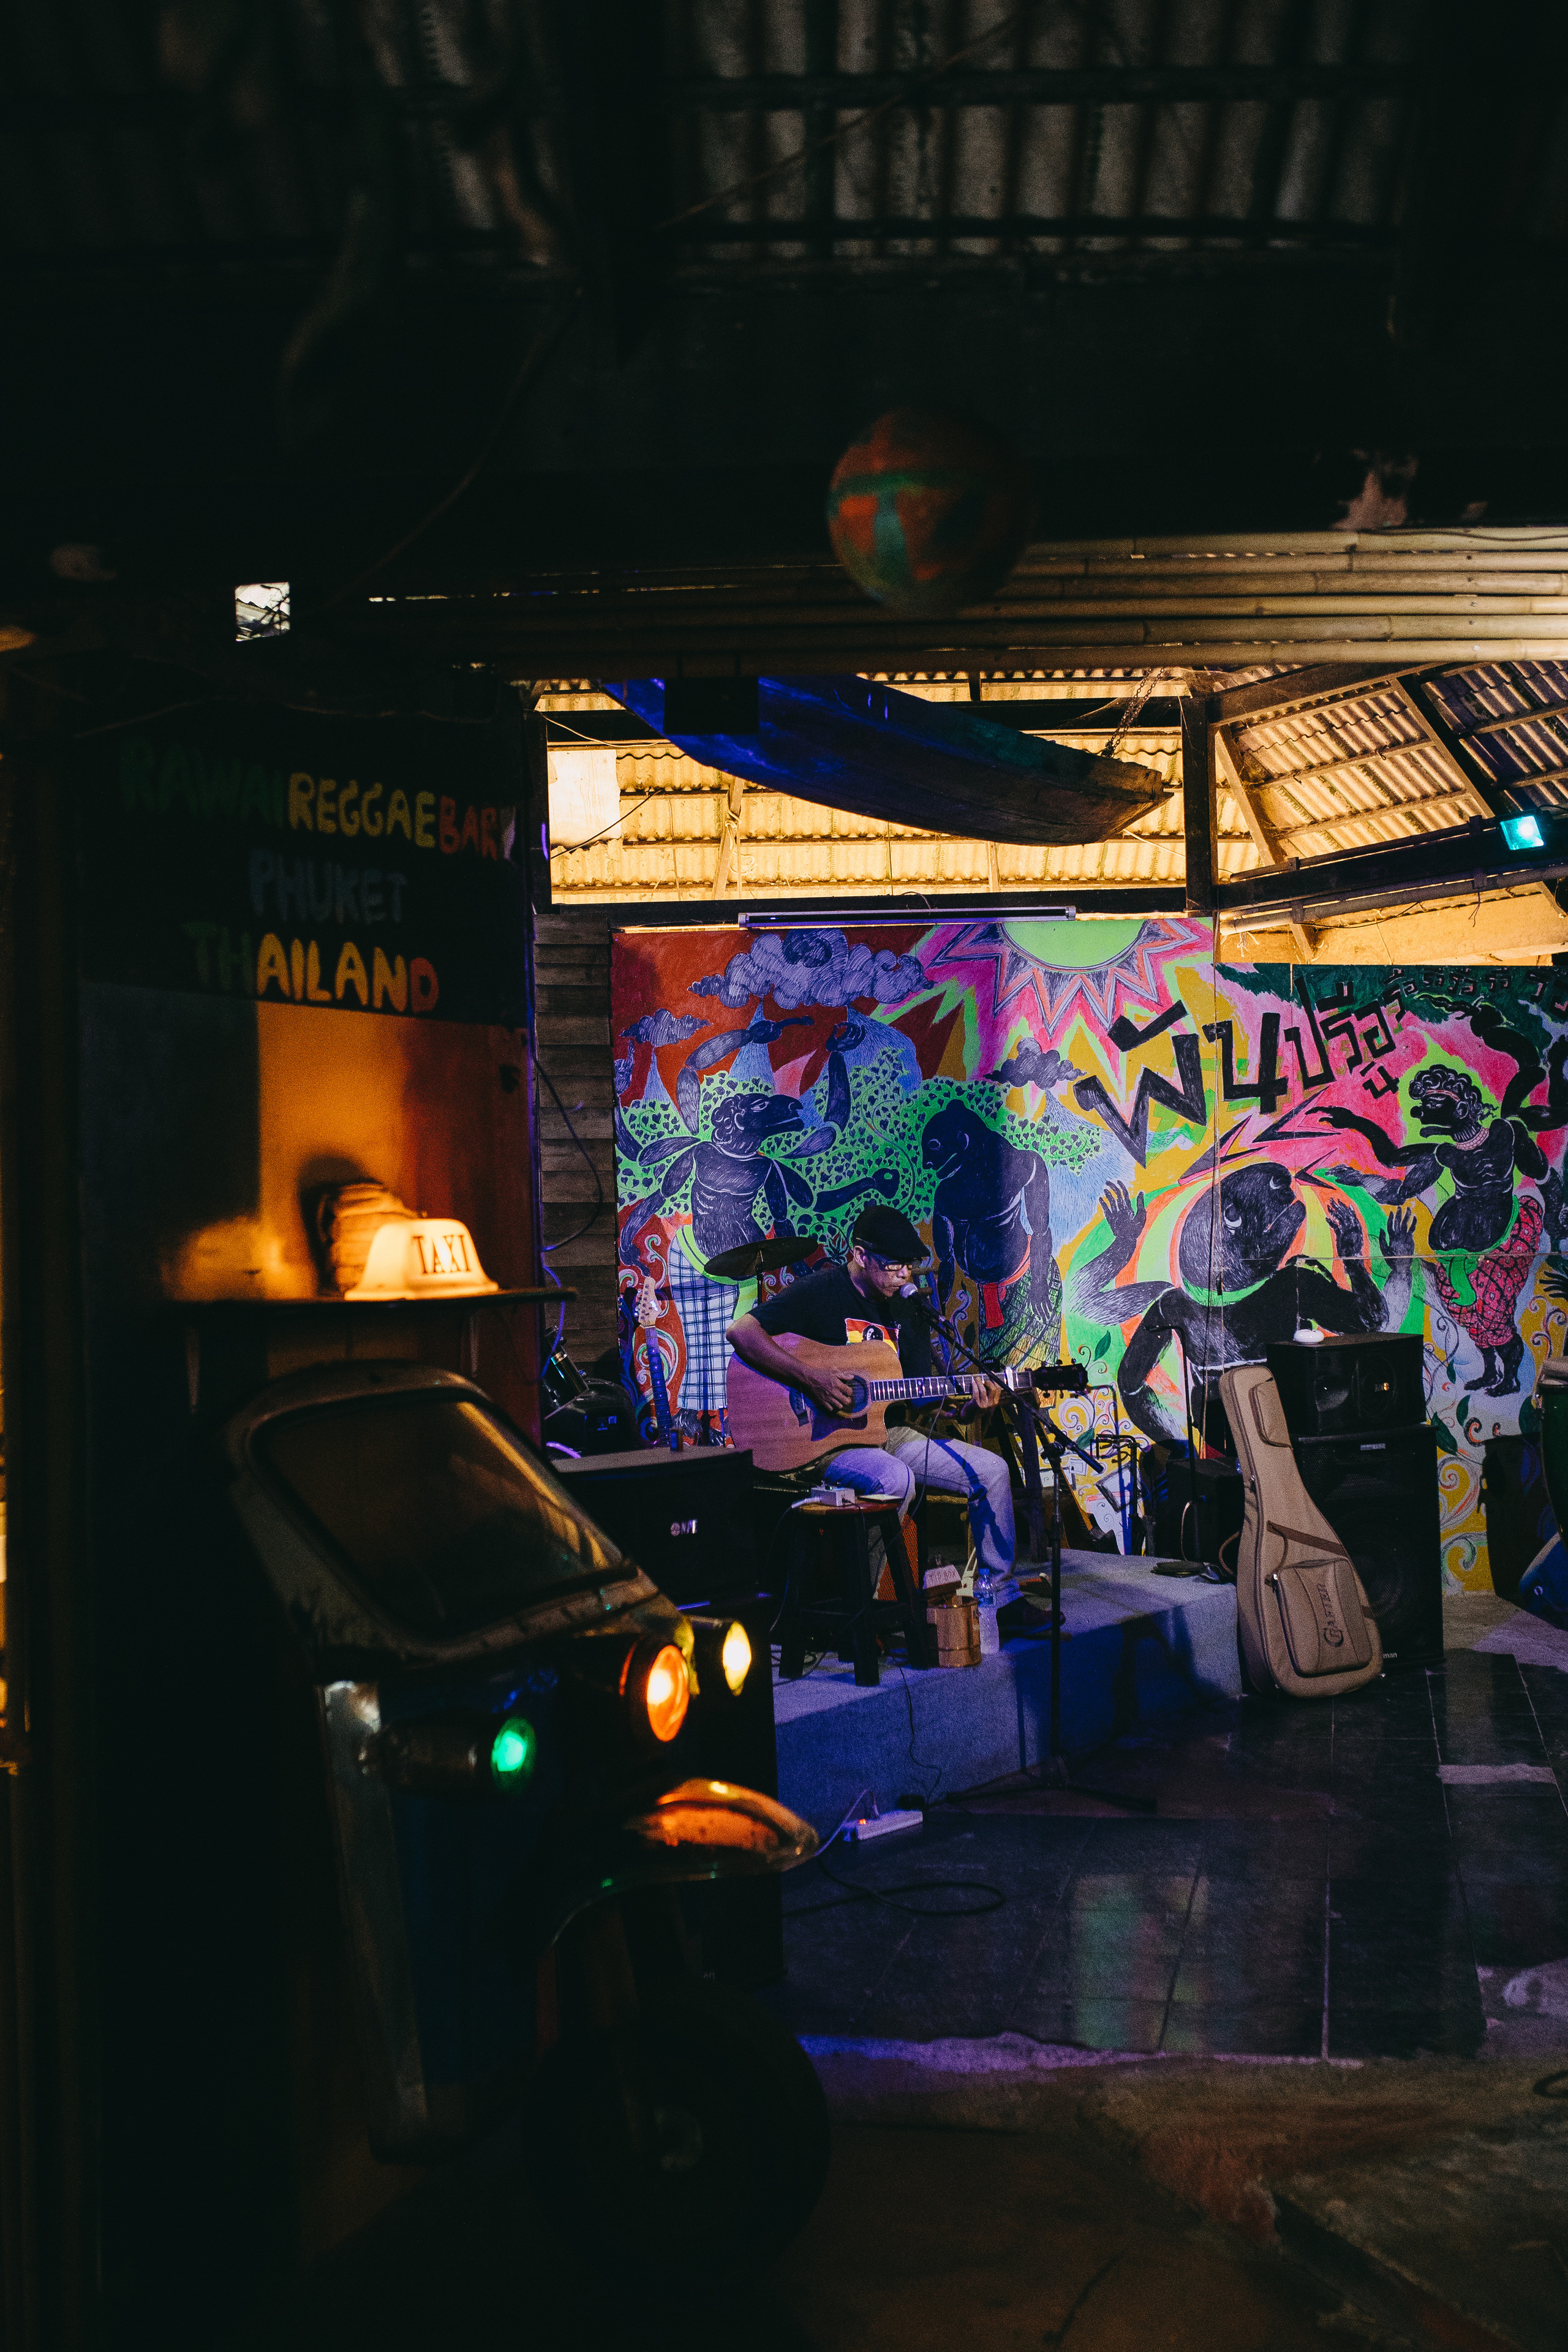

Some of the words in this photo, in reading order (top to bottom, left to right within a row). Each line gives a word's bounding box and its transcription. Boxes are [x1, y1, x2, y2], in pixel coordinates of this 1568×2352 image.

[288, 772, 437, 849] REGGAE
[438, 795, 497, 861] BAR
[247, 848, 409, 924] PHUKET
[184, 921, 440, 1014] THAILAND
[412, 1234, 471, 1275] TAXI
